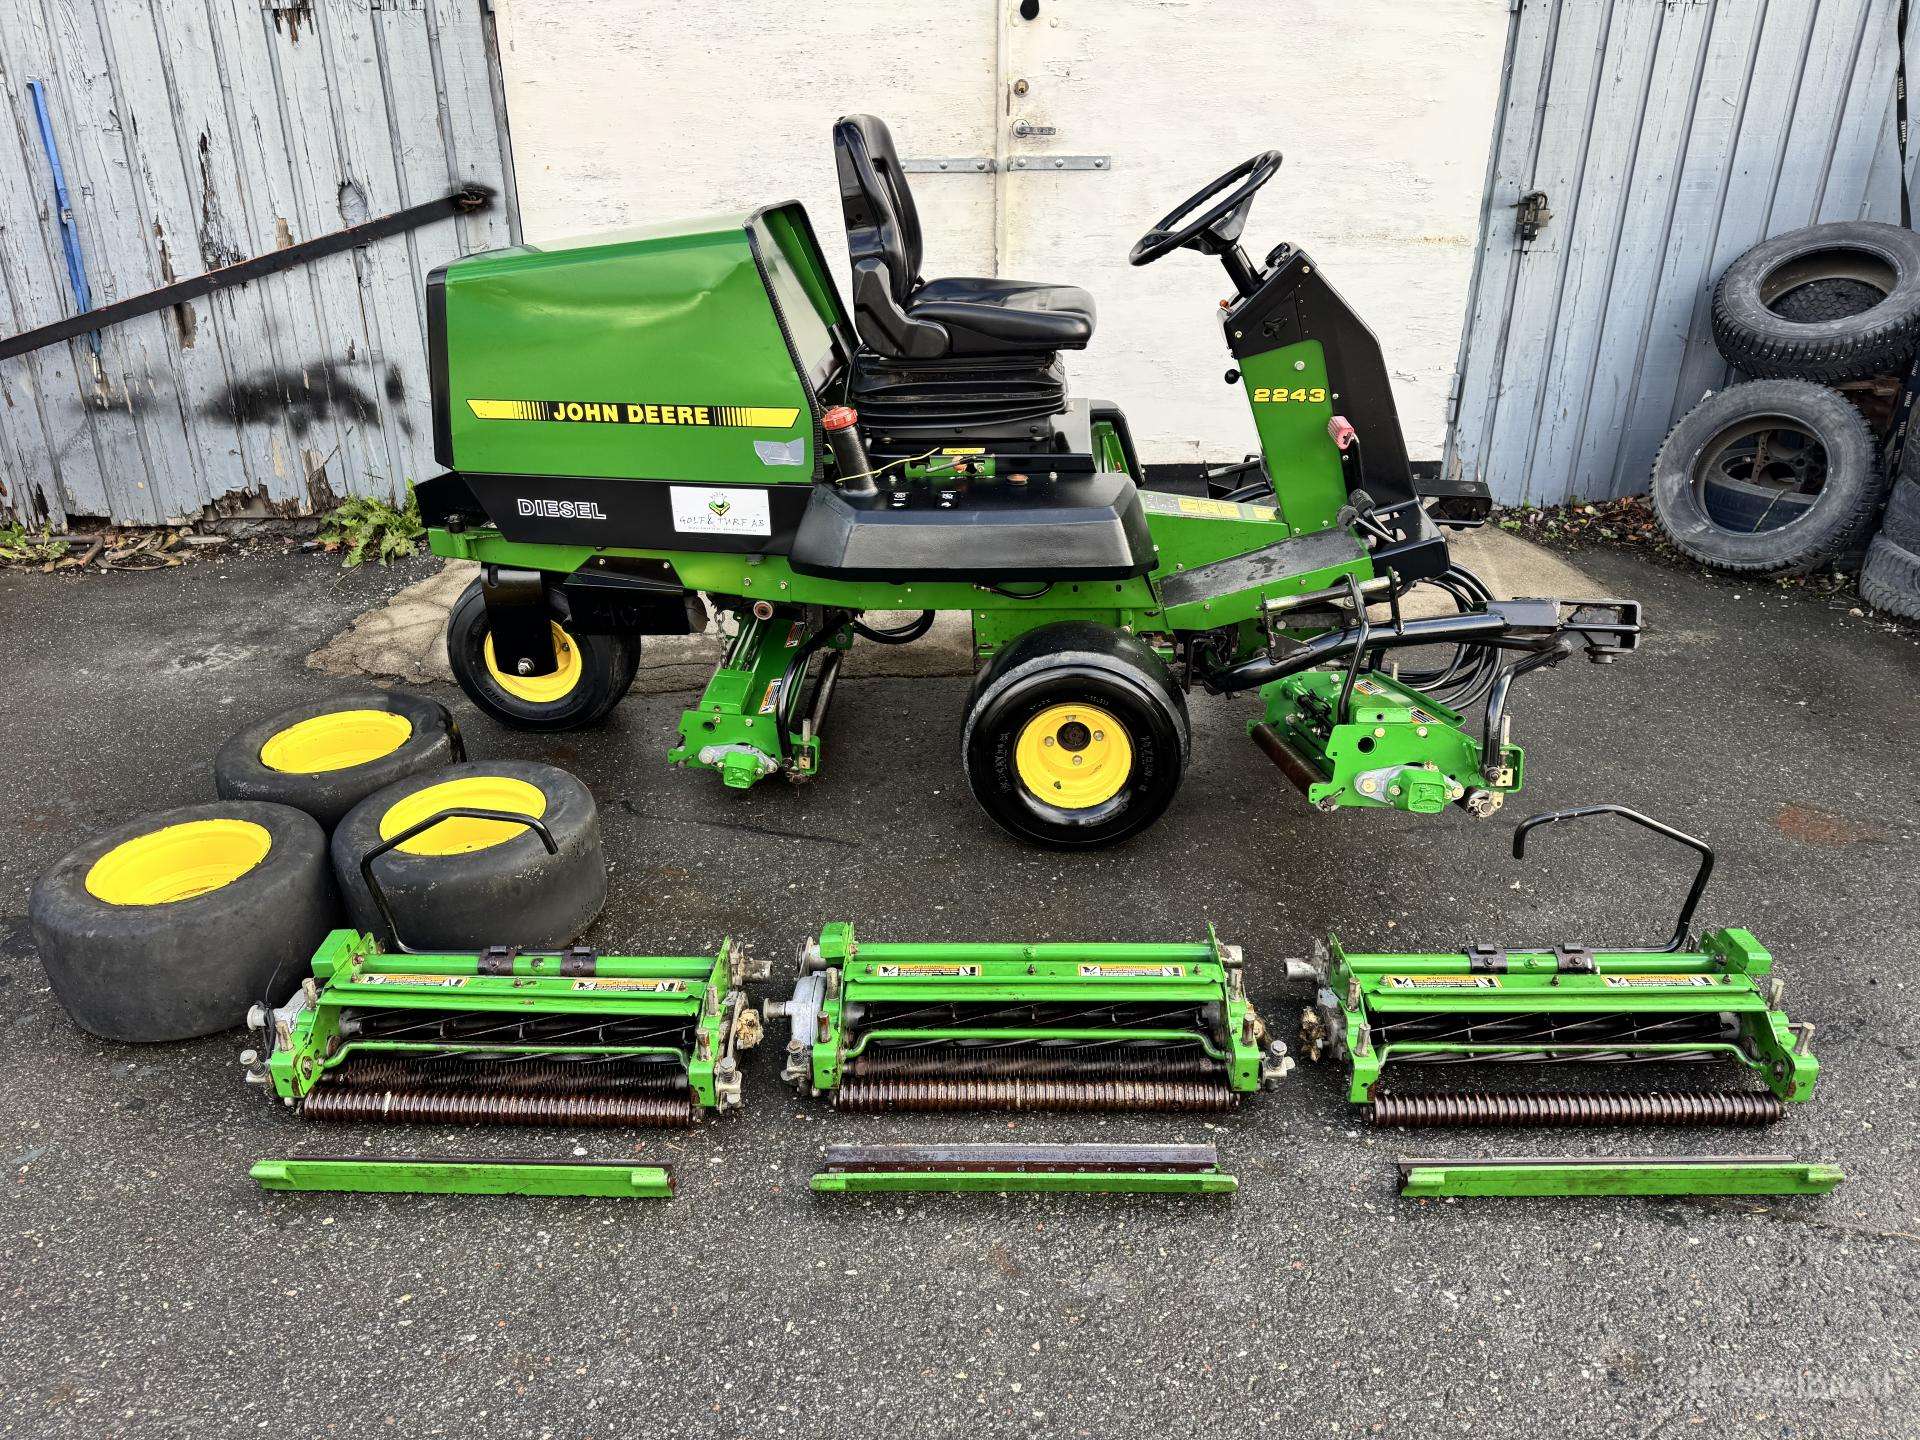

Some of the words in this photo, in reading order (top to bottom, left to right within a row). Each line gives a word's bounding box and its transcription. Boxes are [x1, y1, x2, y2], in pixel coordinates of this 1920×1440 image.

[1253, 387, 1326, 403] 2243
[553, 402, 619, 422] JOHN
[627, 404, 710, 425] DEERE
[517, 498, 607, 520] DIESEL
